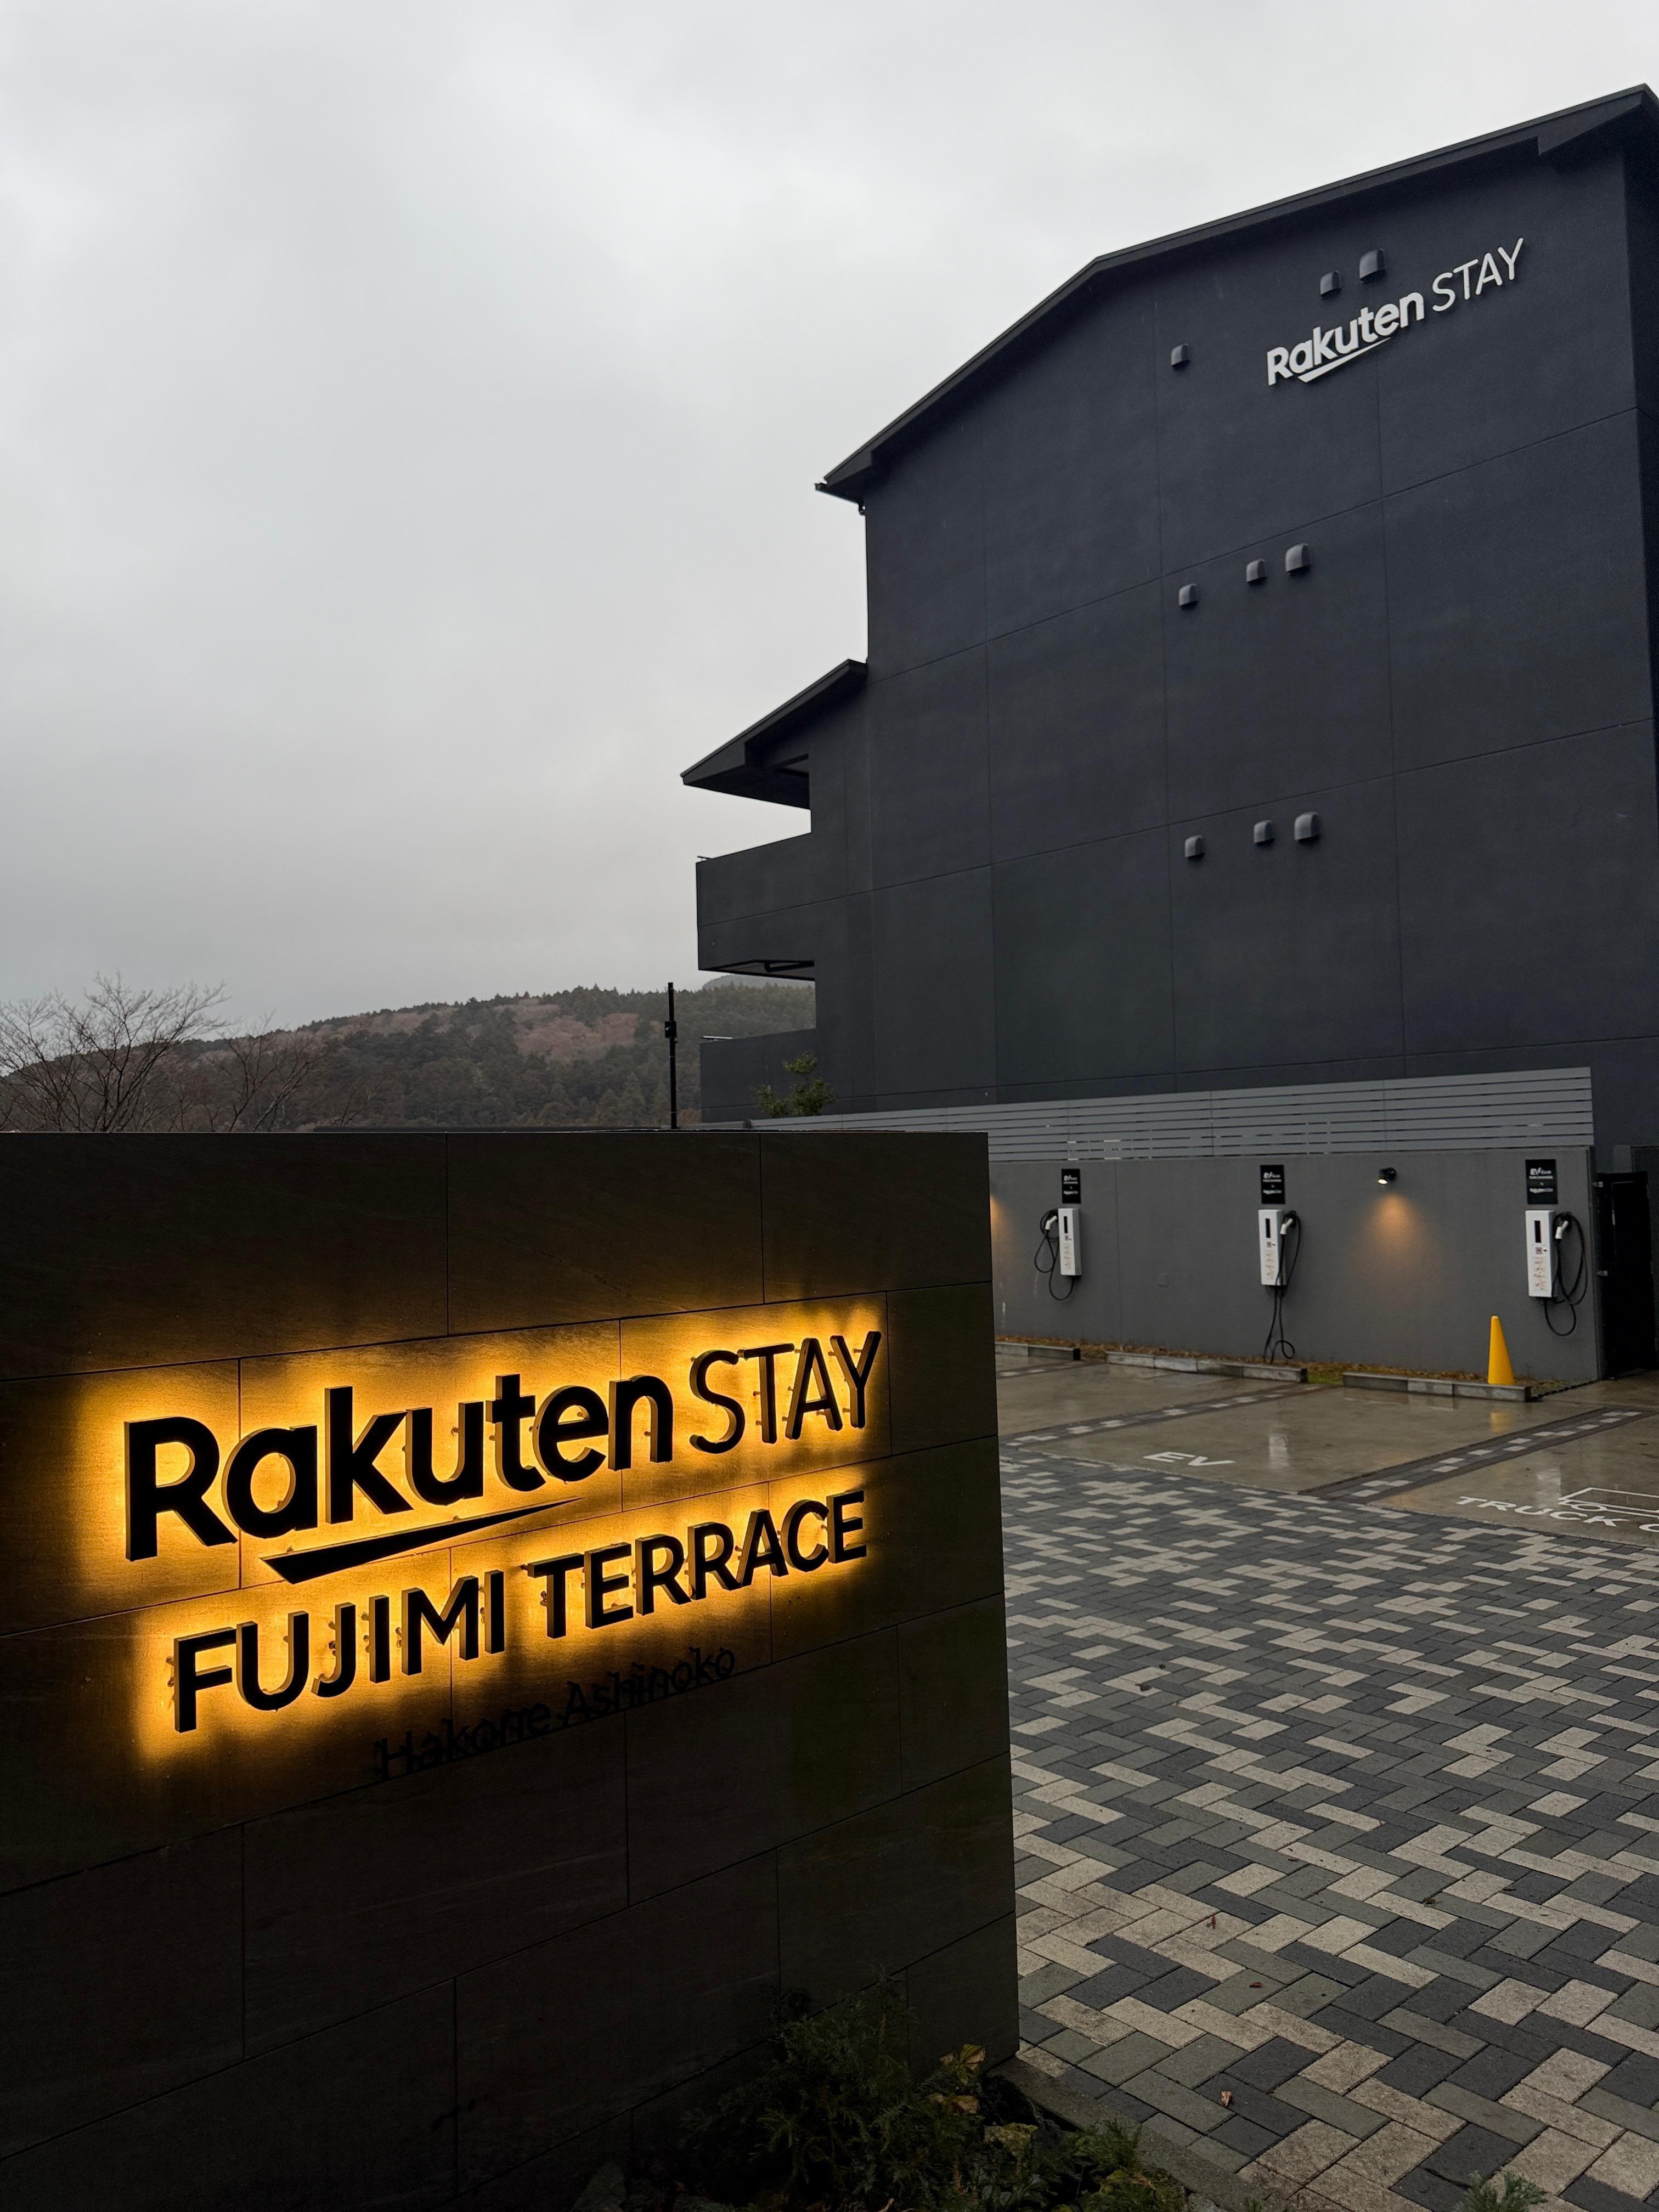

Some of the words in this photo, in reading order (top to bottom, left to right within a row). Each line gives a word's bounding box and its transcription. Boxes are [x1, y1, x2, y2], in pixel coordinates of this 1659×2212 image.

[1267, 292, 1424, 385] Rakuten
[1432, 238, 1523, 312] STAY
[125, 1373, 674, 1562] Rakuten
[689, 1330, 882, 1454] STAY
[1143, 1452, 1235, 1466] EV
[1456, 1496, 1630, 1527] TRUCK
[172, 1570, 505, 1733] FUJIMI
[527, 1489, 867, 1639] TERRACE
[374, 1702, 551, 1781] Hakone
[556, 1646, 736, 1728] Ashinoko
